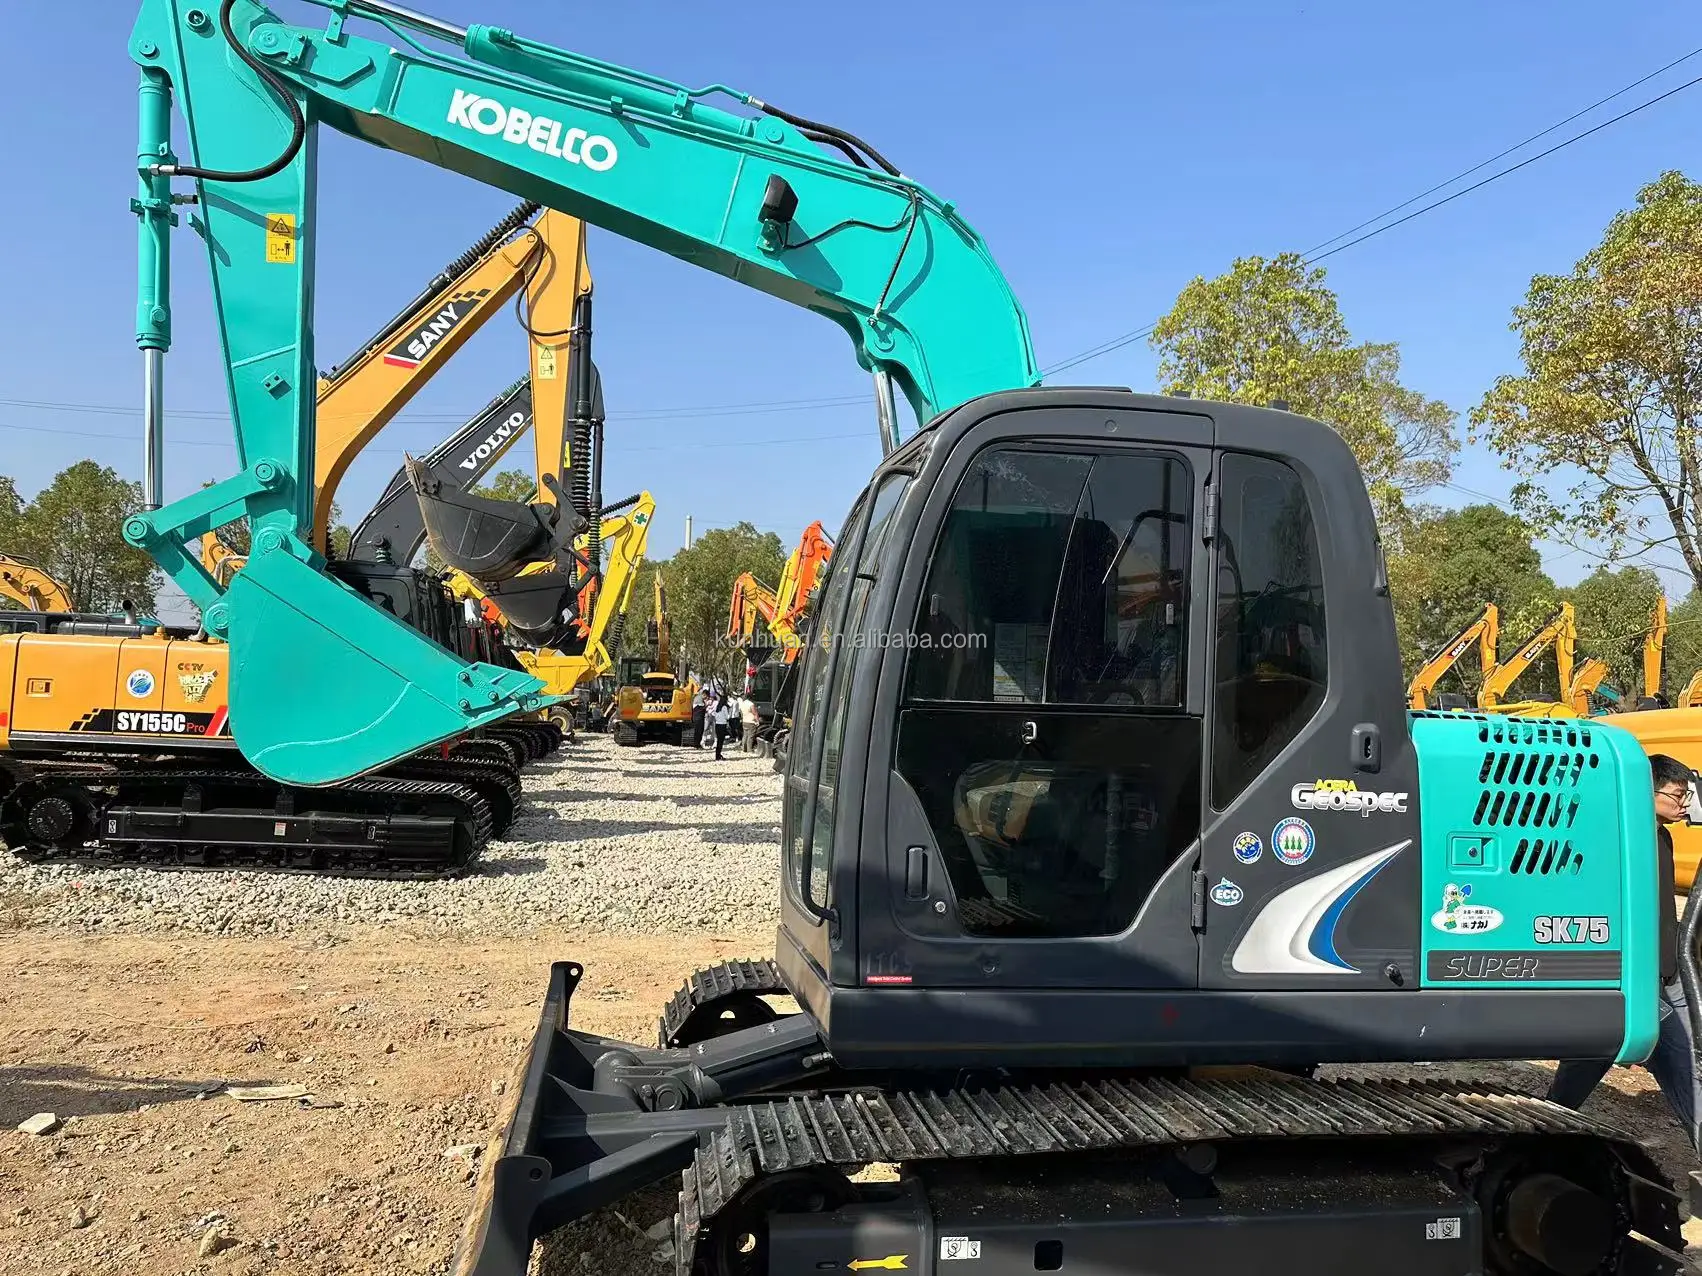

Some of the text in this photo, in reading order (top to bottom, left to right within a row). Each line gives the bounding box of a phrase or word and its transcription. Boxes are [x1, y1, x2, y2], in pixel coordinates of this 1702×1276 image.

[447, 88, 618, 172] KOBELCO
[407, 303, 459, 359] SANY
[459, 412, 524, 470] VOLVO
[177, 662, 204, 671] CCTV
[117, 711, 206, 733] SY155C Pro
[1215, 889, 1240, 900] ECO
[1533, 916, 1610, 944] SK75
[1444, 956, 1539, 978] SUPER
